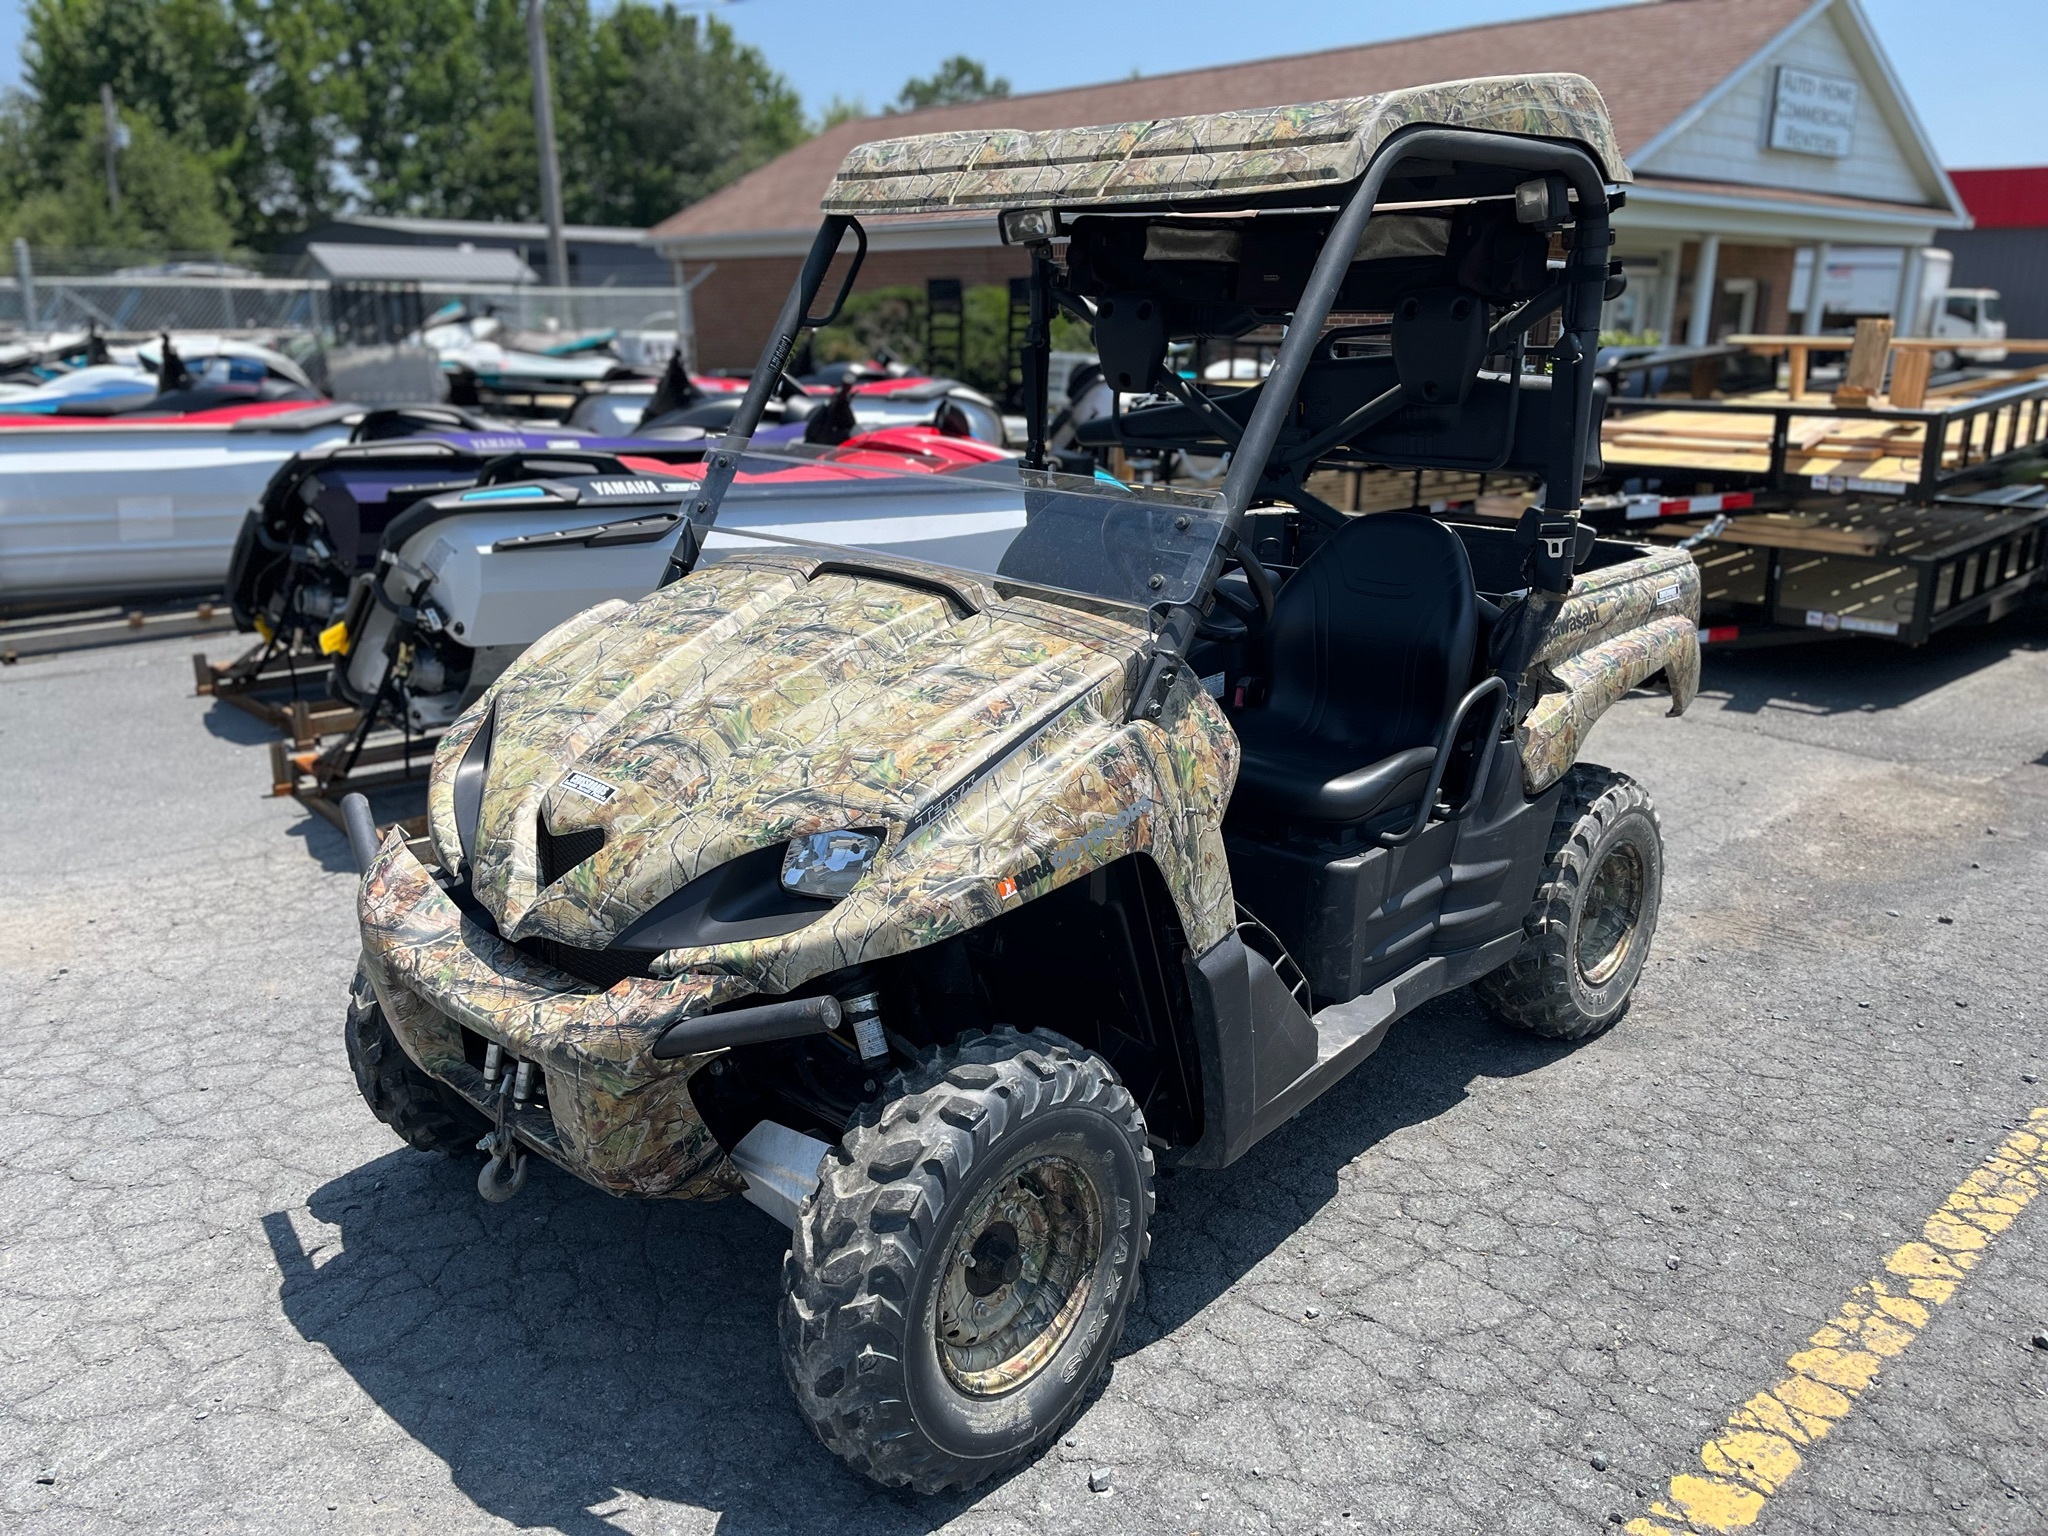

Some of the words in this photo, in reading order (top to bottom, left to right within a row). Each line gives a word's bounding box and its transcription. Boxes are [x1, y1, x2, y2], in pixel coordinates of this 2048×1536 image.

[469, 437, 527, 450] YAMAHA
[589, 480, 660, 496] YAMAHA
[914, 773, 977, 828] TERYX
[1013, 858, 1056, 891] NRA
[1051, 795, 1152, 869] OUTDOORS
[1061, 1196, 1131, 1384] MAXXIS
